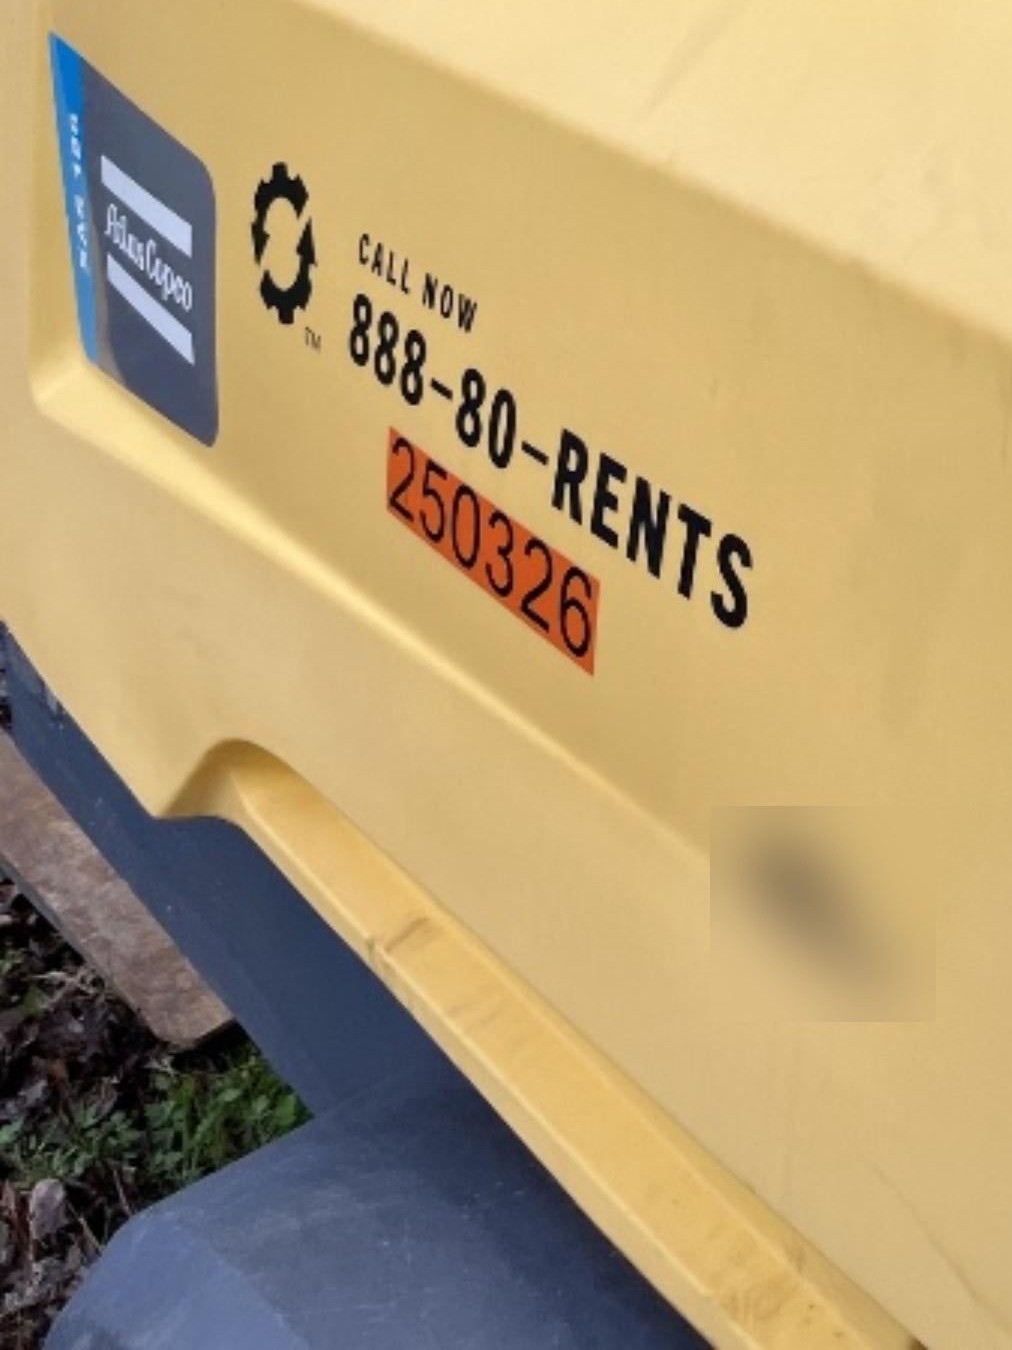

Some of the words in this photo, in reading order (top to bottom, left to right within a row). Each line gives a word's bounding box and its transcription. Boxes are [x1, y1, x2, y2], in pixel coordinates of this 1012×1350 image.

[359, 233, 410, 295] CALL
[422, 273, 478, 333] NOW
[348, 293, 754, 630] 888-80-RENTS
[388, 436, 594, 659] 250326
